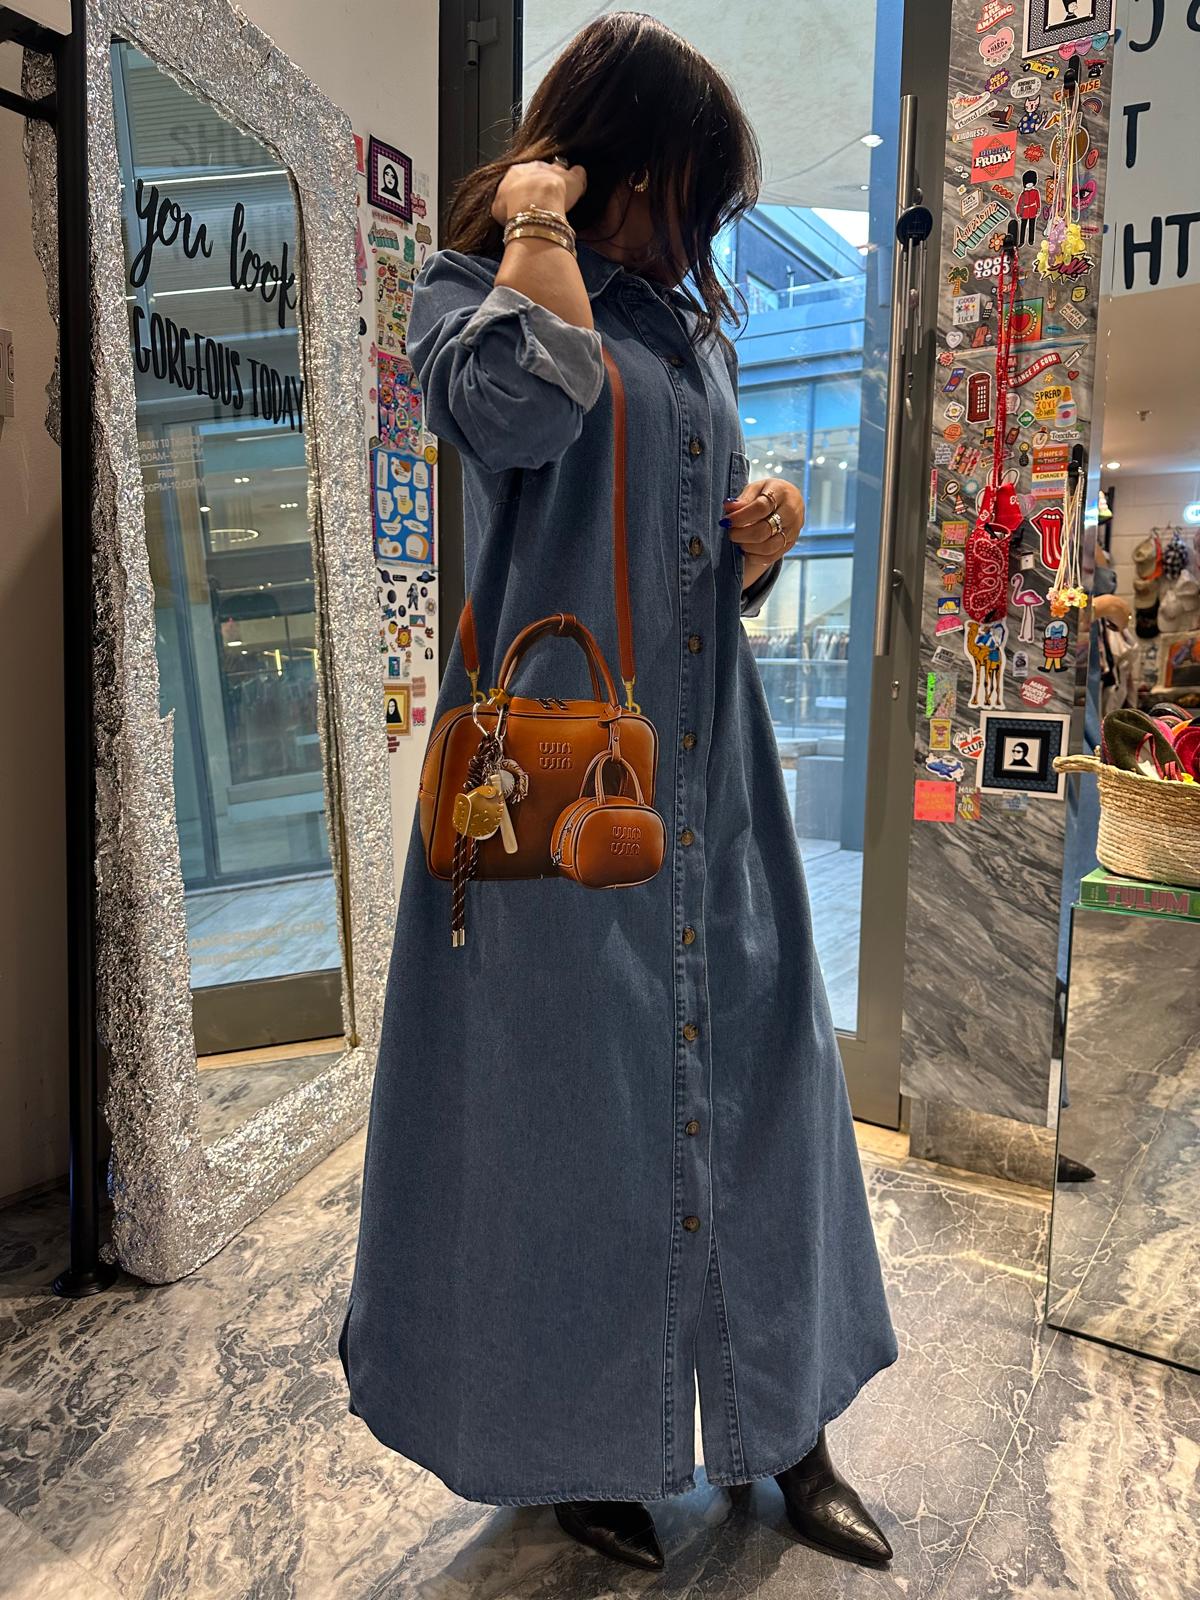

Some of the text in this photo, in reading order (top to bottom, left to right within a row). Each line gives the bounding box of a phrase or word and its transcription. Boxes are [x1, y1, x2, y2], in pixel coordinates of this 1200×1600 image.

[974, 150, 1015, 168] FRIDAY
[133, 305, 304, 433] GORGEOUS TODAY
[1009, 354, 1057, 386] CHANGE IS GOOD
[1034, 389, 1062, 401] SPREAD
[1052, 431, 1079, 440] Together
[961, 740, 985, 754] CLUB
[1106, 884, 1190, 915] TULUM
